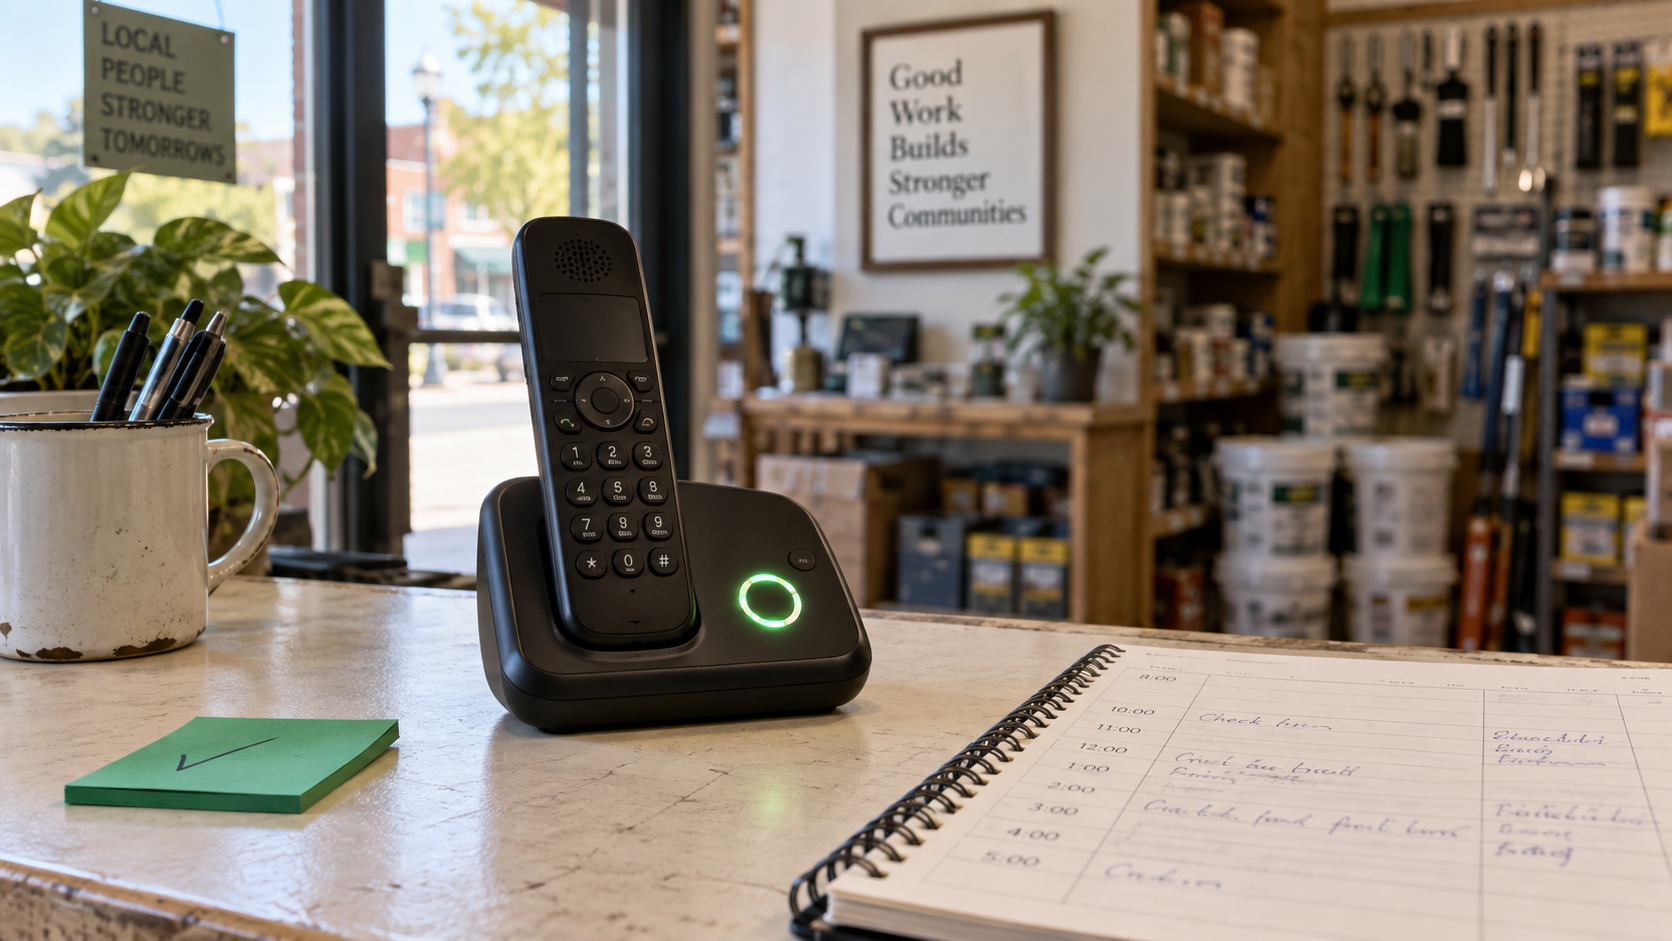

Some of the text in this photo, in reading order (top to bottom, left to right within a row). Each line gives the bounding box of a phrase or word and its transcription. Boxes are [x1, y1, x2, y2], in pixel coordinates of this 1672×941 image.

[101, 20, 177, 60] LOCAL
[101, 57, 186, 95] PEOPLE
[889, 57, 963, 92] Good
[100, 92, 212, 132] STRONGER
[890, 94, 963, 126] Work
[100, 127, 226, 167] TOMORROWS
[889, 130, 970, 162] Builds
[888, 169, 991, 200] Stronger
[887, 199, 1028, 230] Communities
[571, 445, 653, 459] 1 2 3
[576, 481, 586, 494] 4
[581, 518, 591, 530] 7
[654, 515, 663, 528] 9
[623, 554, 633, 567] 0
[659, 554, 669, 567] #
[1110, 706, 1155, 716] 10:00
[1199, 713, 1262, 726] Check
[1097, 723, 1142, 734] 11:00
[1079, 742, 1128, 754] 12:00
[1067, 761, 1110, 773] 1:00
[1047, 781, 1096, 794] 2:00
[1027, 802, 1079, 816] 3:00
[1006, 827, 1060, 842] 4:00
[980, 851, 1041, 868] 5:00
